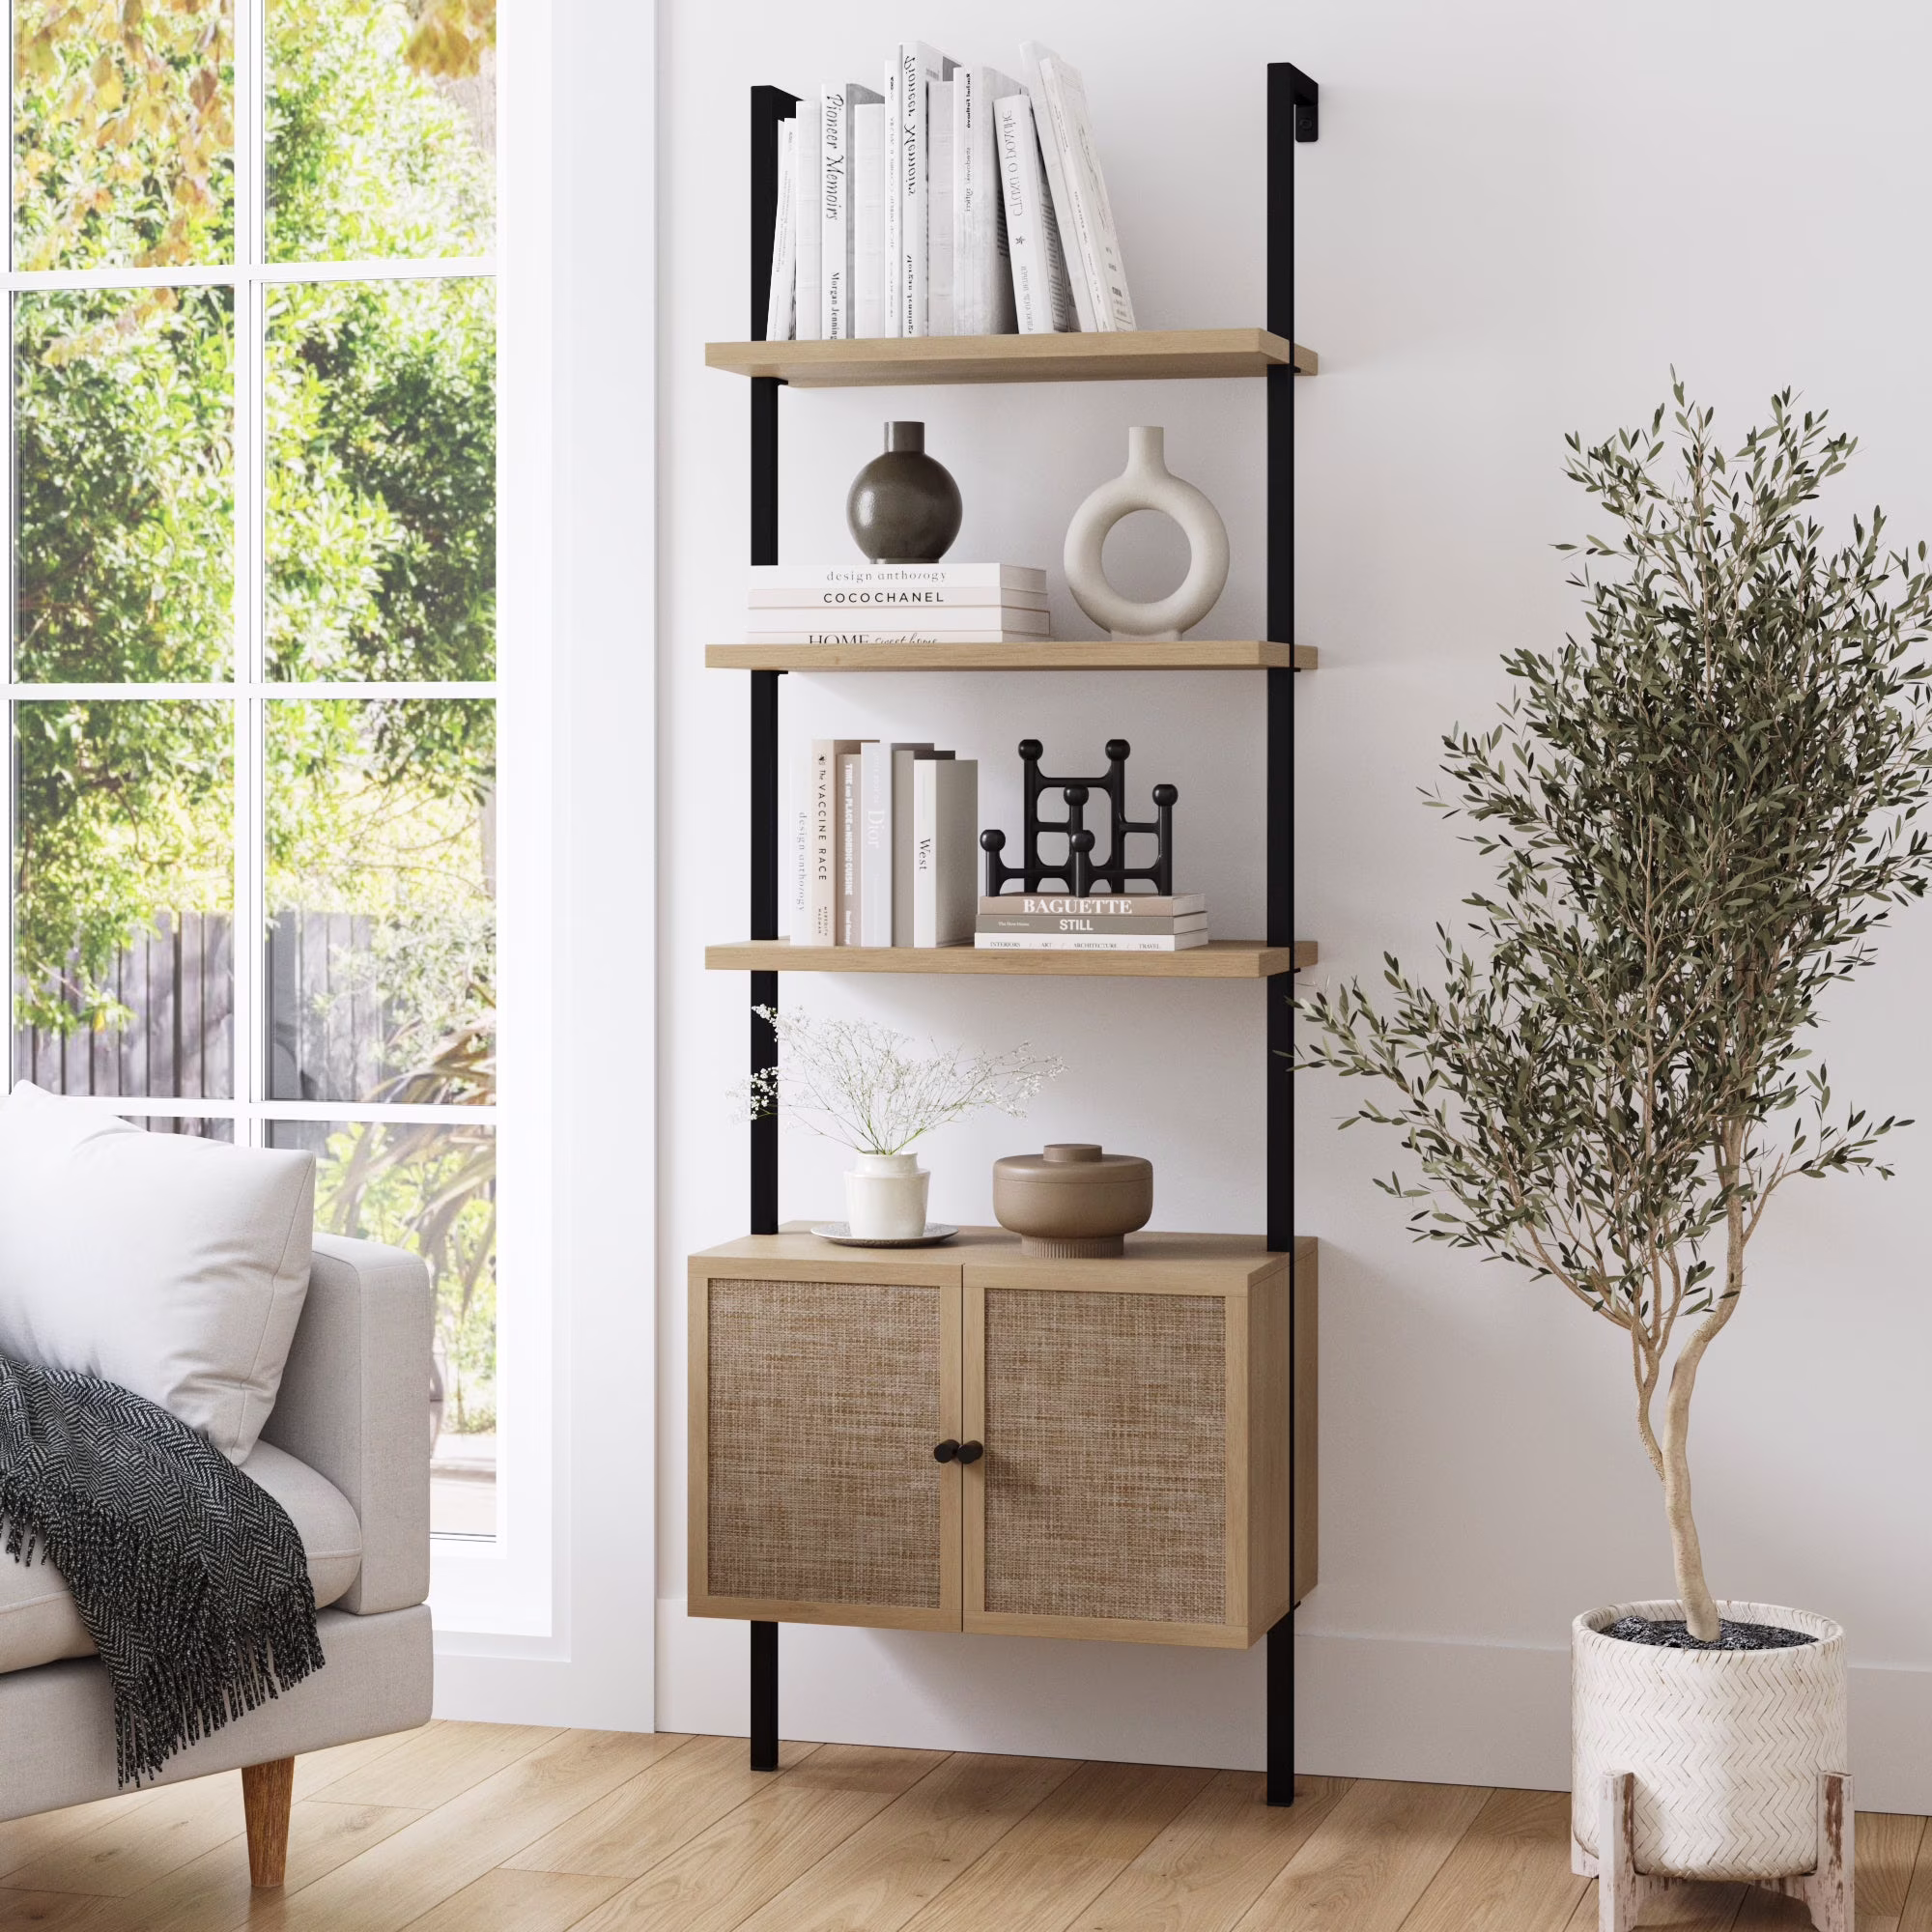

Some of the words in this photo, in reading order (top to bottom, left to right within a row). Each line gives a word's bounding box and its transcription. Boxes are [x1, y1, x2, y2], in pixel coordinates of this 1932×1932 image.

[826, 94, 844, 150] Pioneer
[826, 155, 844, 221] Memoirs
[829, 271, 840, 305] Morgan
[829, 306, 840, 339] Jenning
[826, 571, 872, 583] design
[809, 634, 869, 644] HOME
[817, 769, 827, 781] The
[817, 783, 827, 840] VACCINE
[797, 811, 809, 850] design
[867, 809, 885, 849] Dior
[817, 847, 827, 881] RACE
[919, 838, 931, 870] West
[1024, 899, 1132, 914] BAGUETTE
[1059, 919, 1094, 931] STILL
